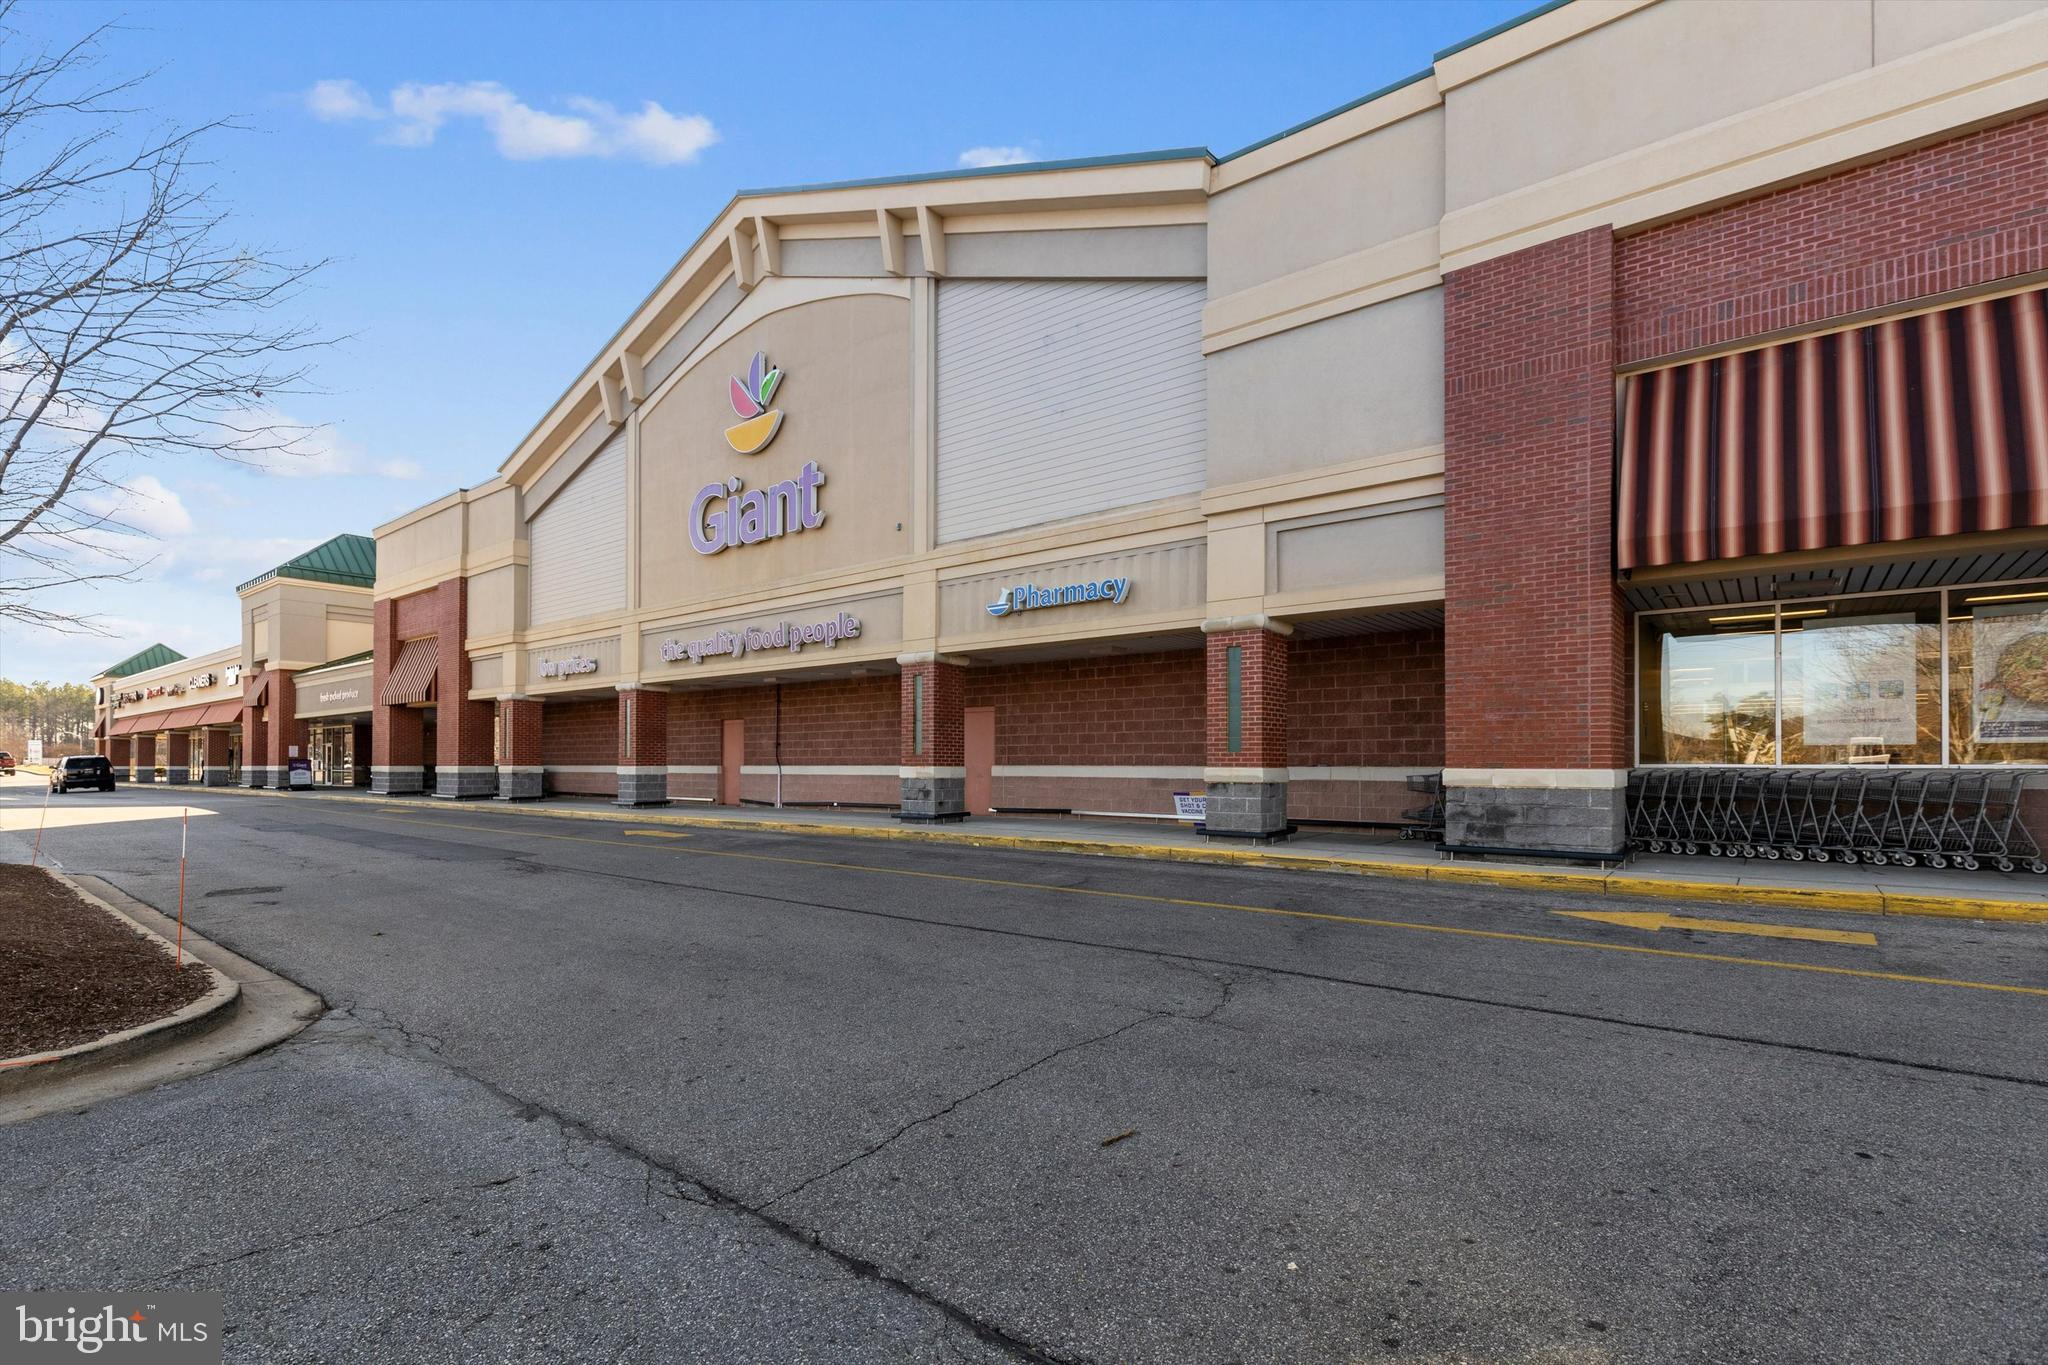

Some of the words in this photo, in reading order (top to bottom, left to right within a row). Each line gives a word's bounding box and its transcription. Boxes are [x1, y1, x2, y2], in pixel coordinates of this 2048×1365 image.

[689, 460, 825, 555] Giant
[1013, 576, 1129, 610] Pharmacy
[660, 639, 687, 662] the
[688, 630, 744, 664] quality
[744, 622, 788, 652] food
[790, 611, 858, 652] people
[538, 655, 557, 677] low
[558, 656, 594, 681] prices
